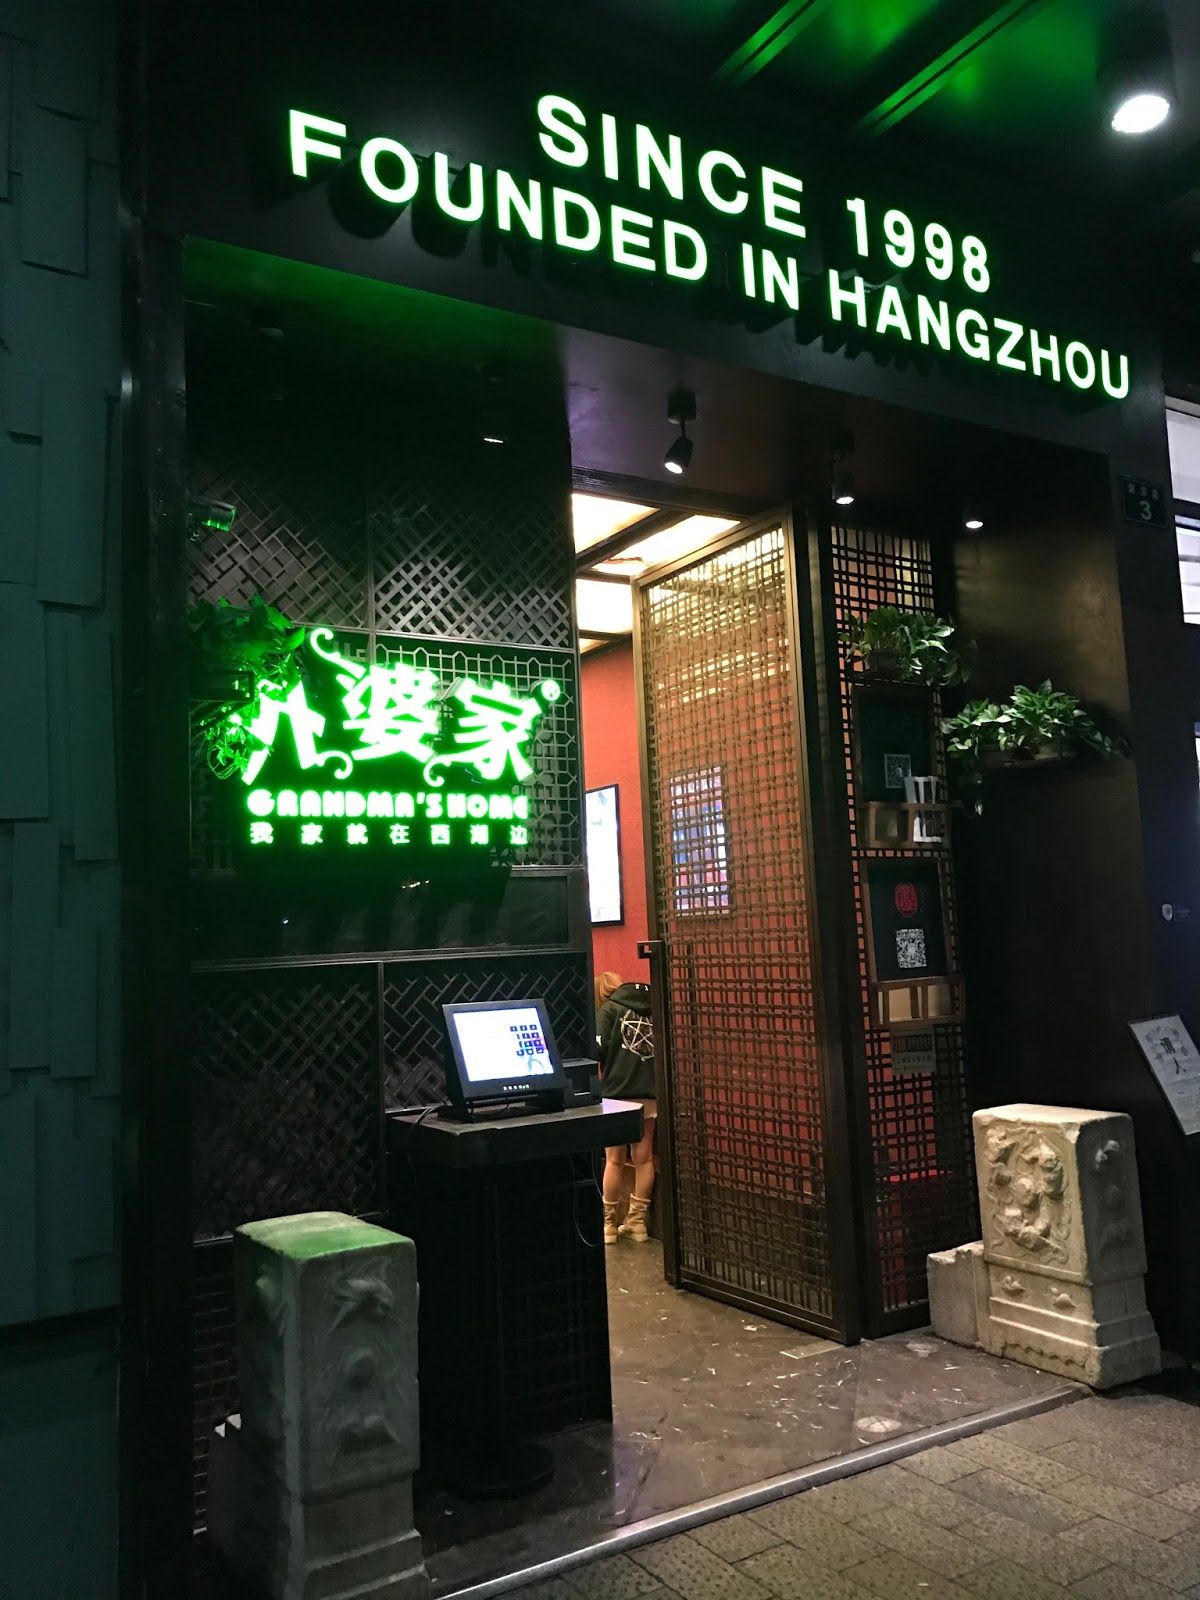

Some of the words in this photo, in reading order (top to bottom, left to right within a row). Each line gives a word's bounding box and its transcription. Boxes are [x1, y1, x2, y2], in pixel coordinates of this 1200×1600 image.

[536, 94, 807, 239] SINCE
[845, 196, 991, 294] 1998
[288, 108, 708, 282] FOUNDED
[741, 242, 800, 311] IN
[828, 268, 1131, 400] HANGZHOU
[1139, 499, 1153, 521] 3
[246, 788, 443, 820] GRANDMA'S
[446, 792, 530, 821] HOME
